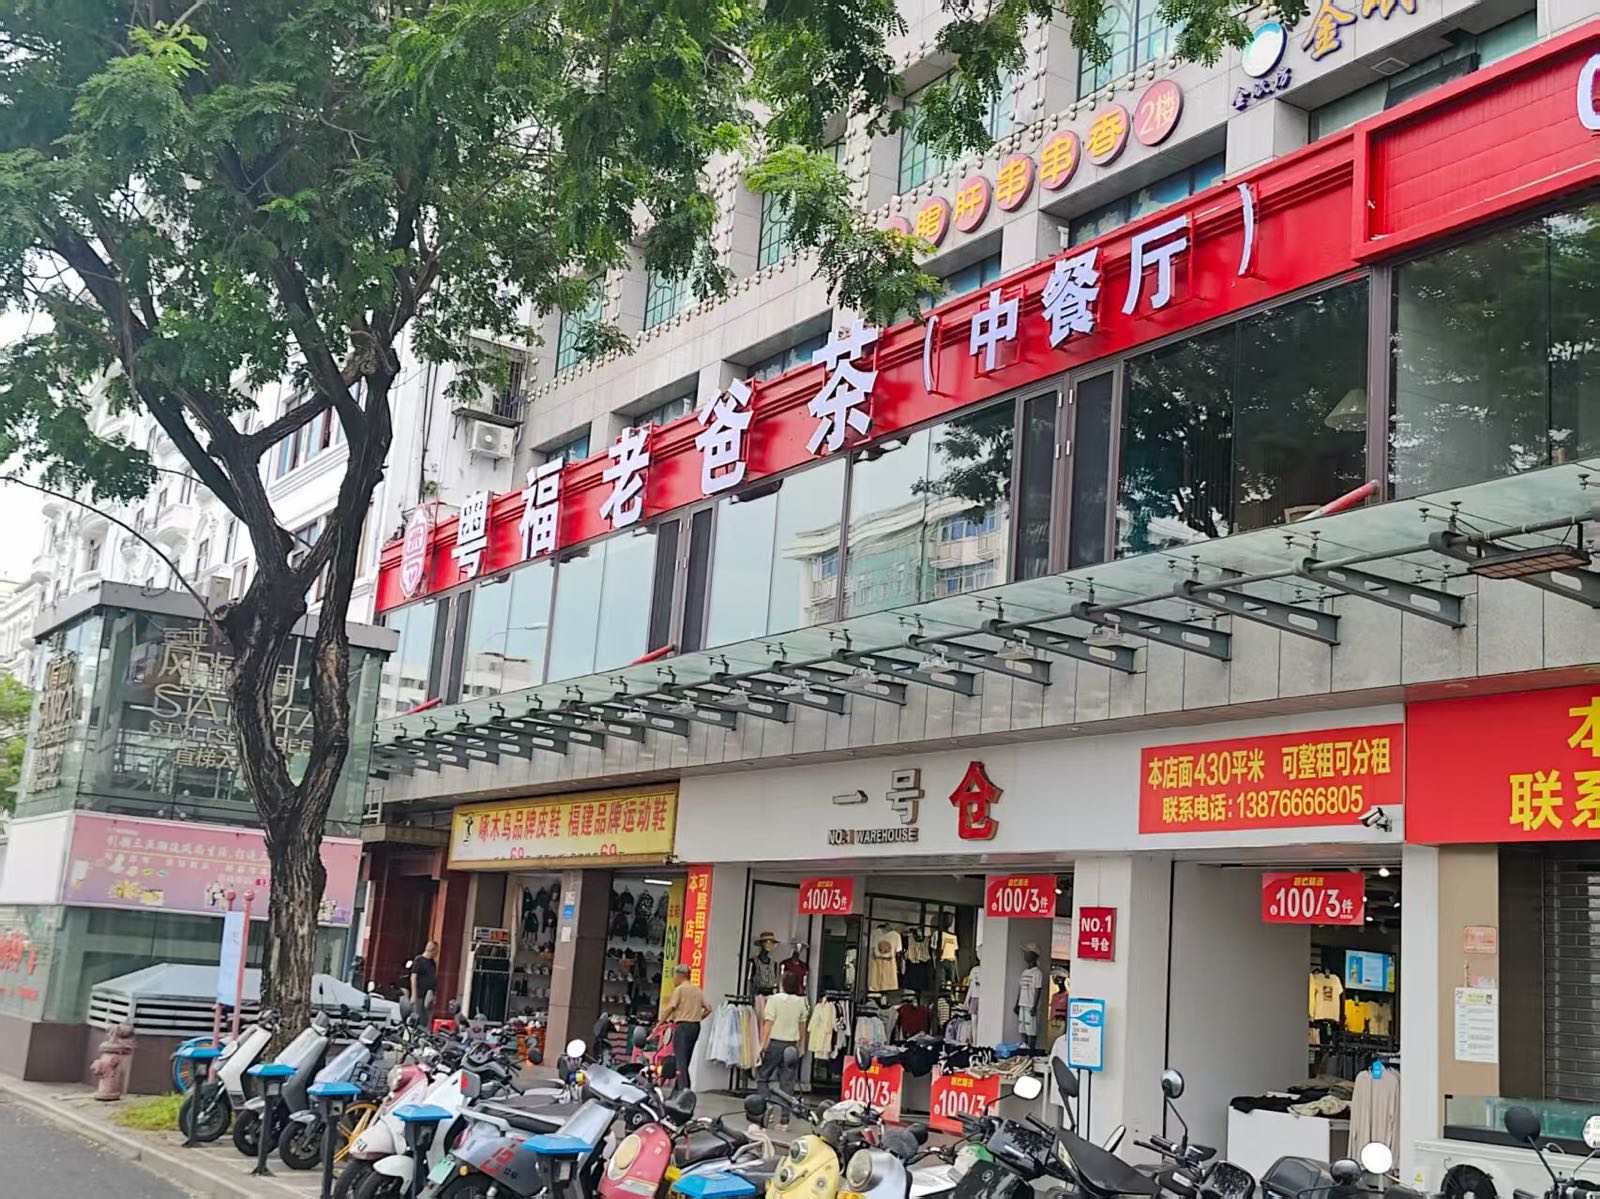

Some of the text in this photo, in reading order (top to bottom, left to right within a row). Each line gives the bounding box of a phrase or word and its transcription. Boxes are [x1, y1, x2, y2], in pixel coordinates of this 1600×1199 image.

[1148, 738, 1391, 790] 本店面430平米 可整租可分租
[832, 761, 1004, 840] 一号仓
[568, 797, 668, 838] 福建品牌运动鞋
[856, 827, 919, 844] WAREHOUSE
[1081, 915, 1112, 933] NO.1
[1080, 937, 1110, 952] 一号仓
